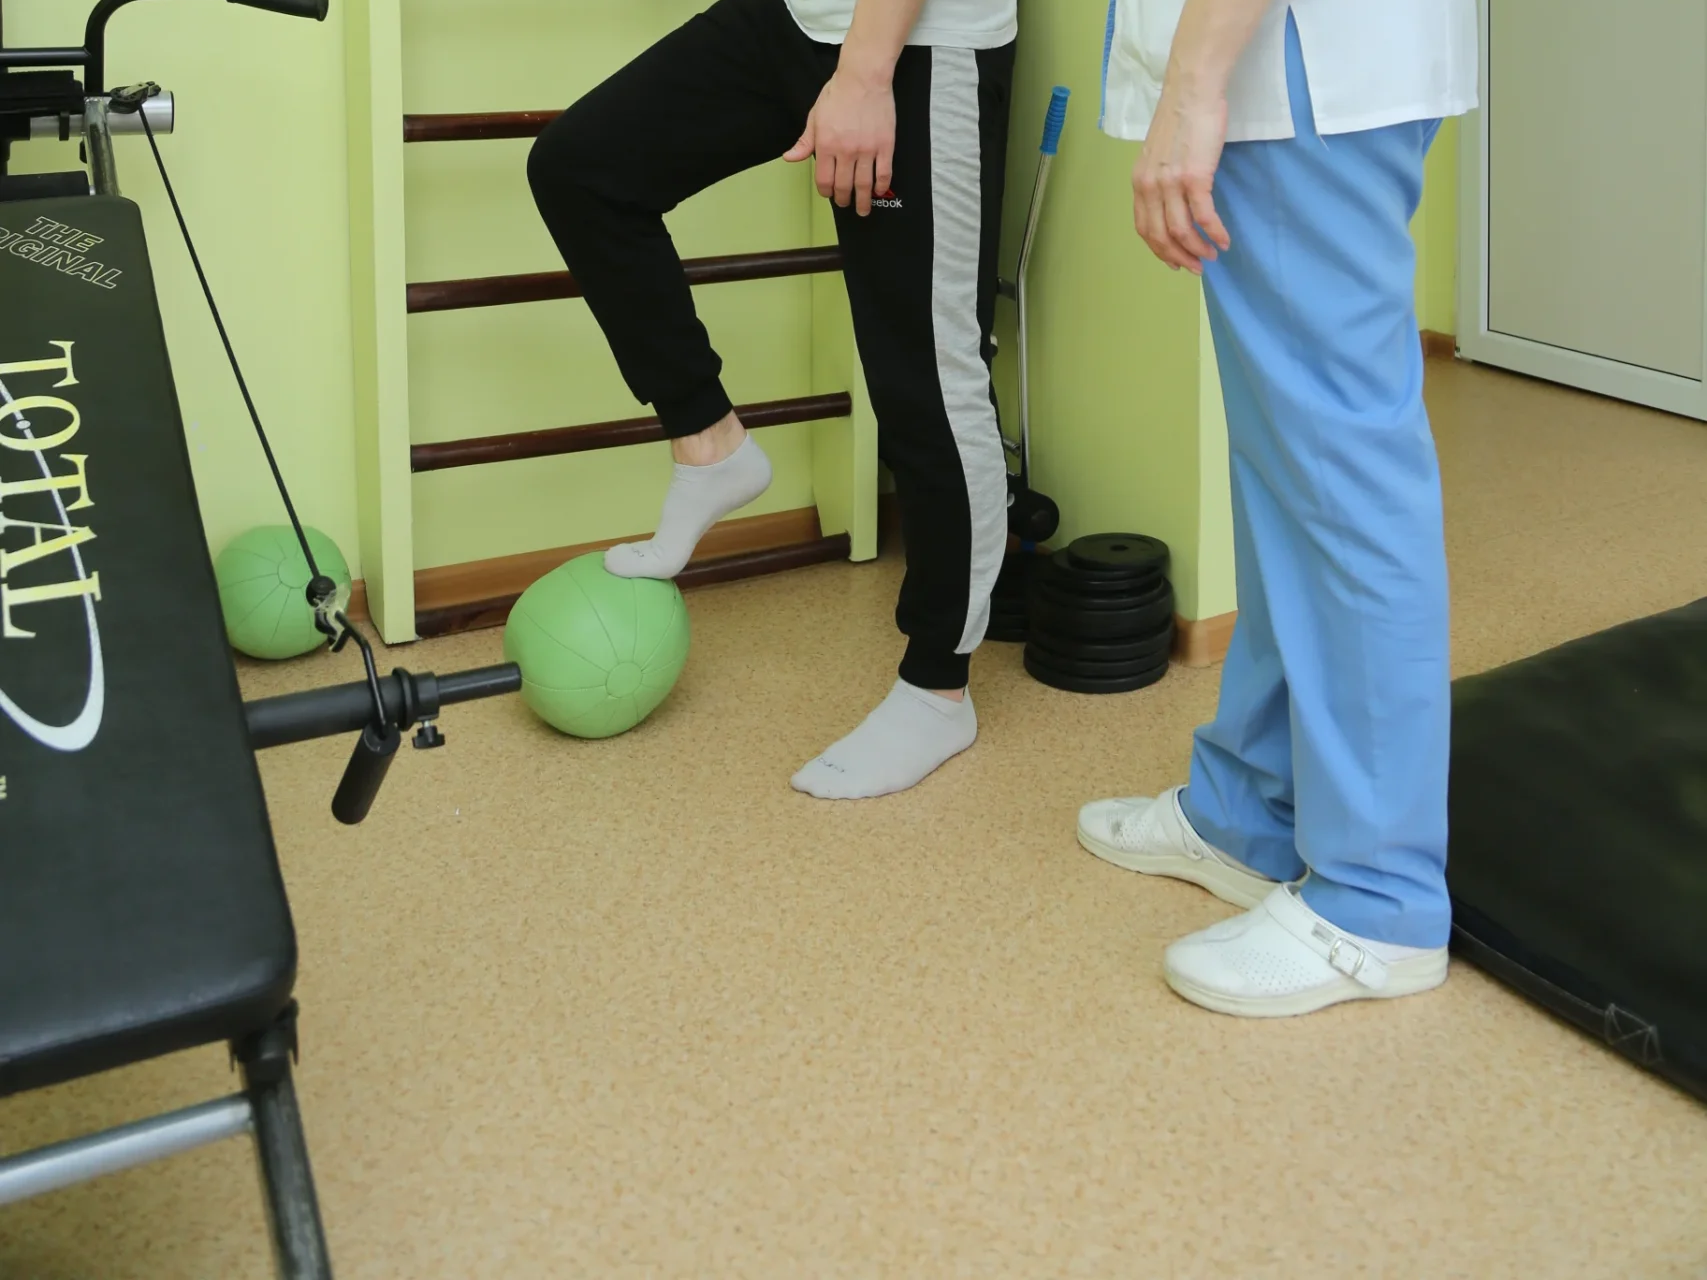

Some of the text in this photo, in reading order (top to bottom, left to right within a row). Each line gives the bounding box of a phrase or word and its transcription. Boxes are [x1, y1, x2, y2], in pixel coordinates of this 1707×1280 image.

[871, 198, 903, 208] eebok
[0, 226, 123, 289] IGINAL
[25, 216, 105, 253] THE
[0, 340, 102, 638] TOTAL
